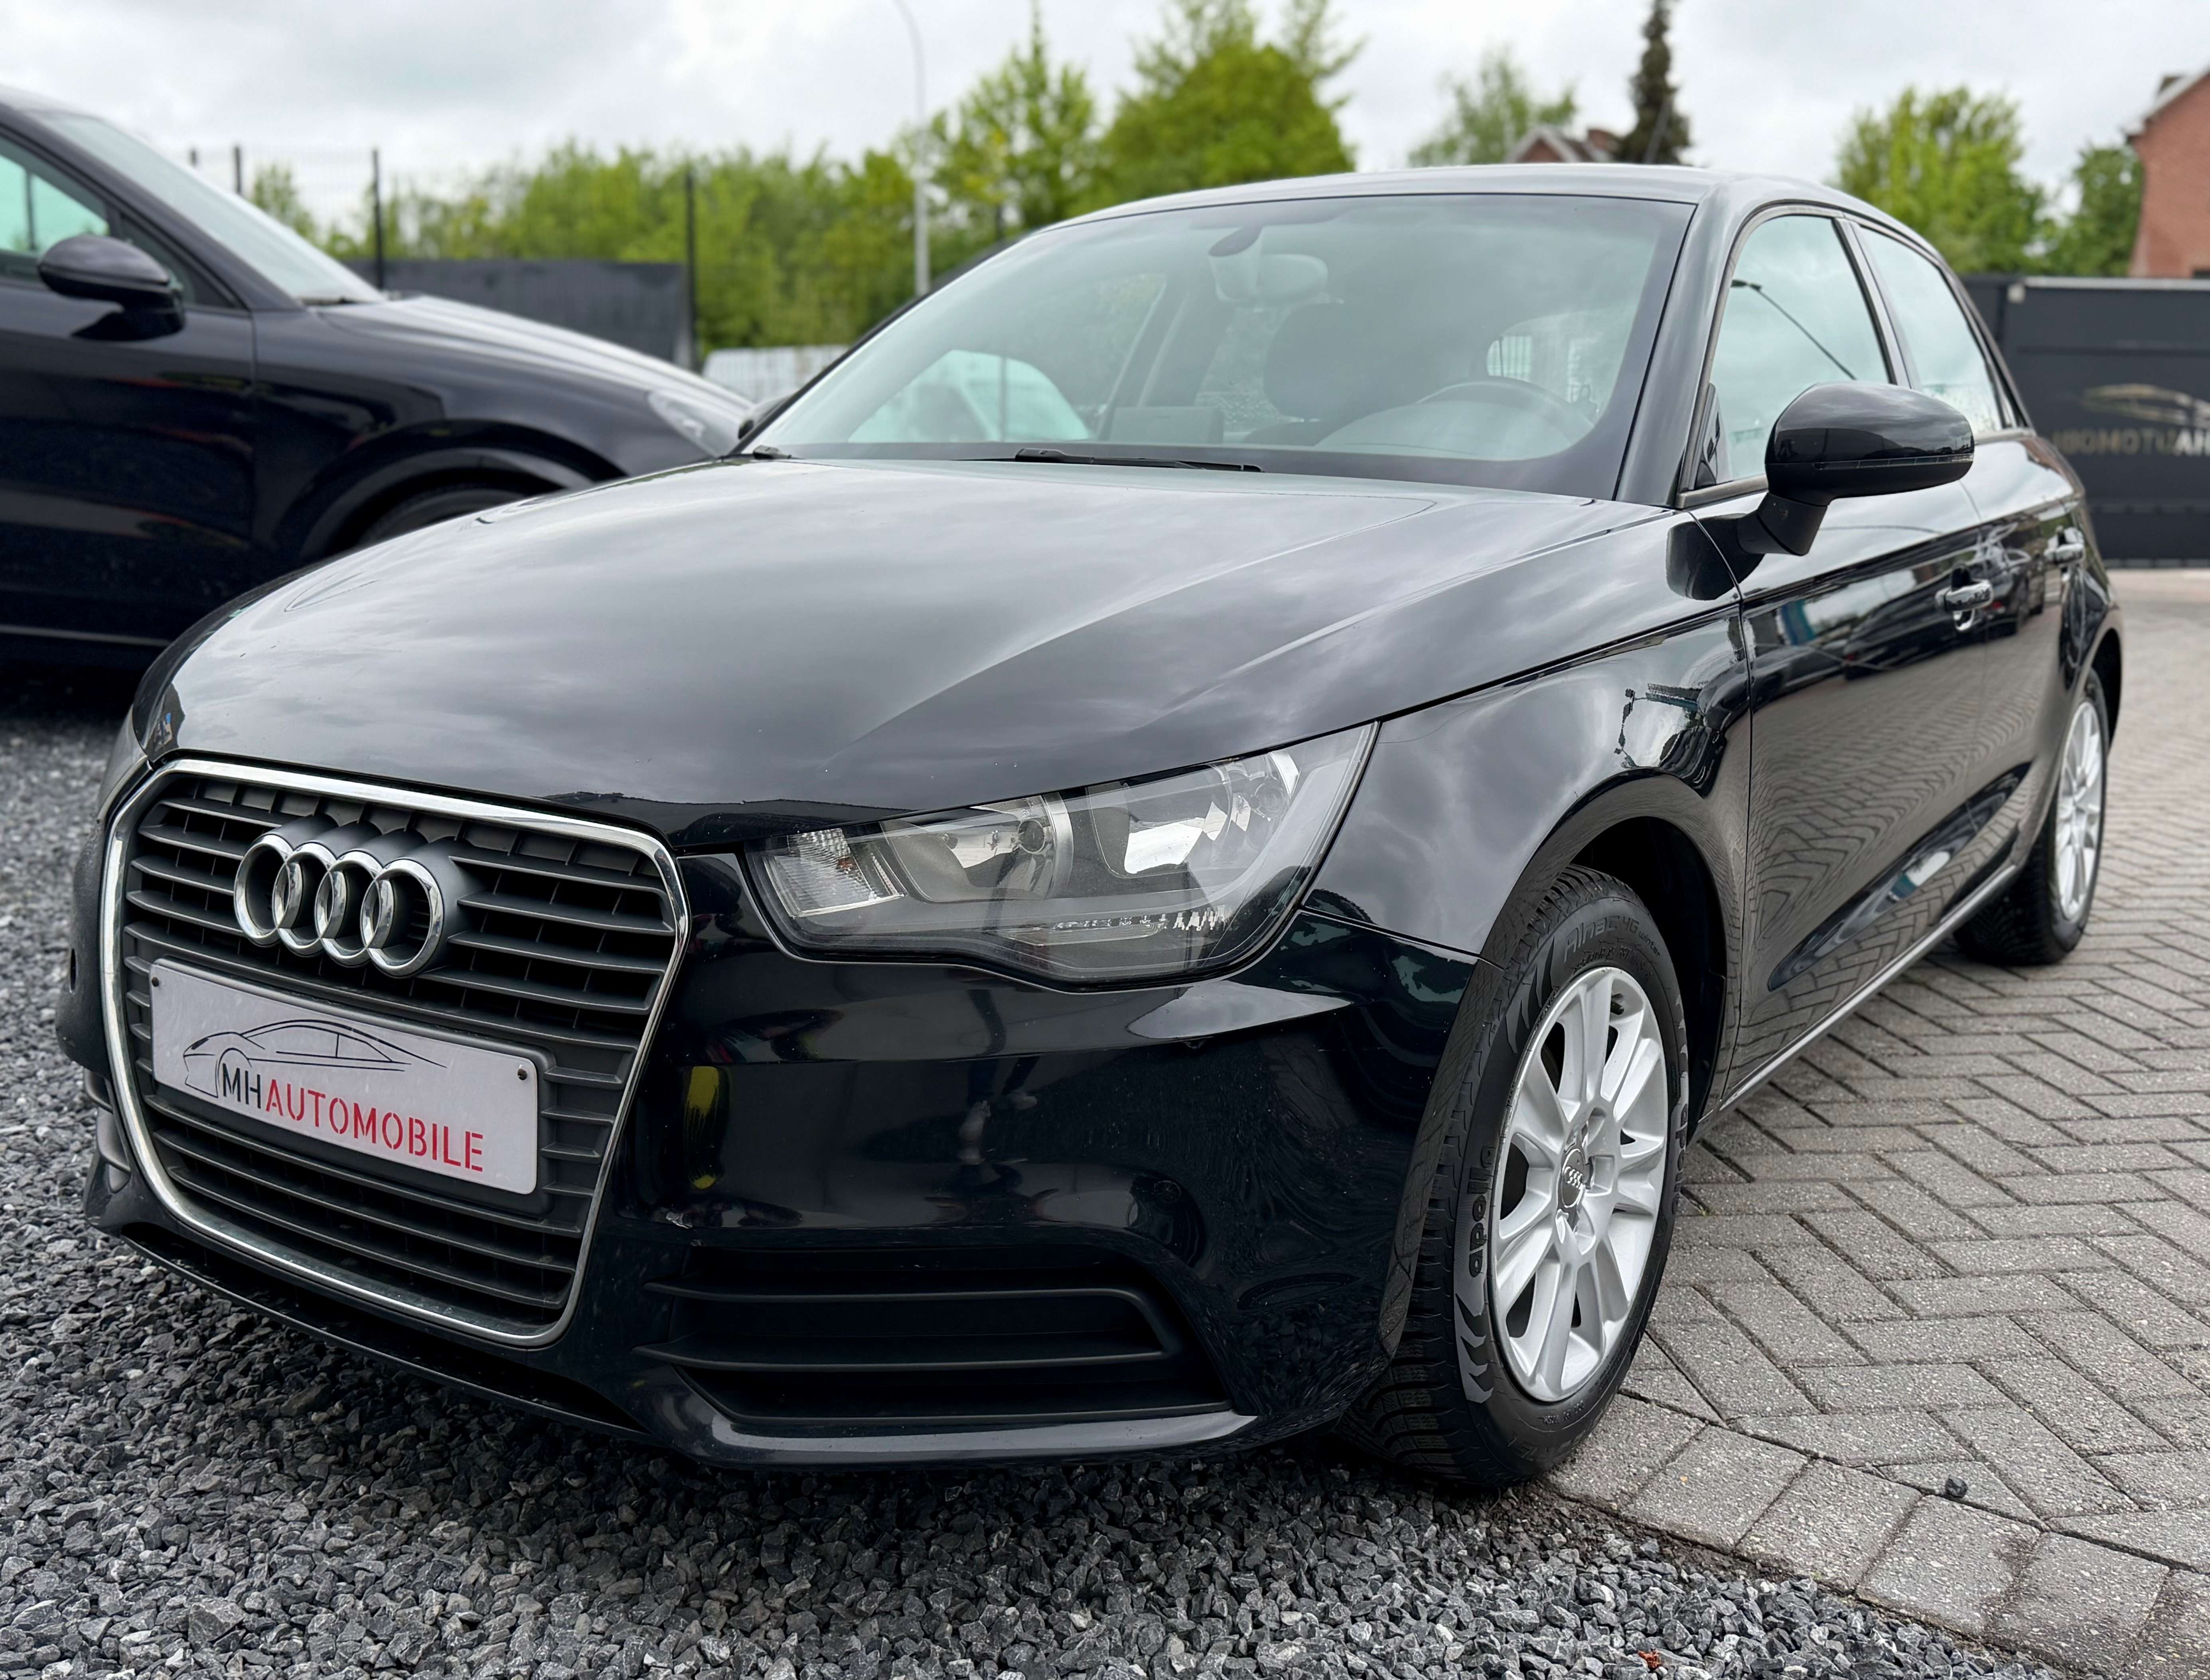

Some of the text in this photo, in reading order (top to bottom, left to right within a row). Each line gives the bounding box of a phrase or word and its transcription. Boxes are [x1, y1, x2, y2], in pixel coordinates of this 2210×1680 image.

[1623, 916, 1640, 935] 4G
[1638, 931, 1661, 956] winter
[222, 1063, 483, 1172] MHAUTOMOBILE
[1467, 1146, 1496, 1277] apollo
